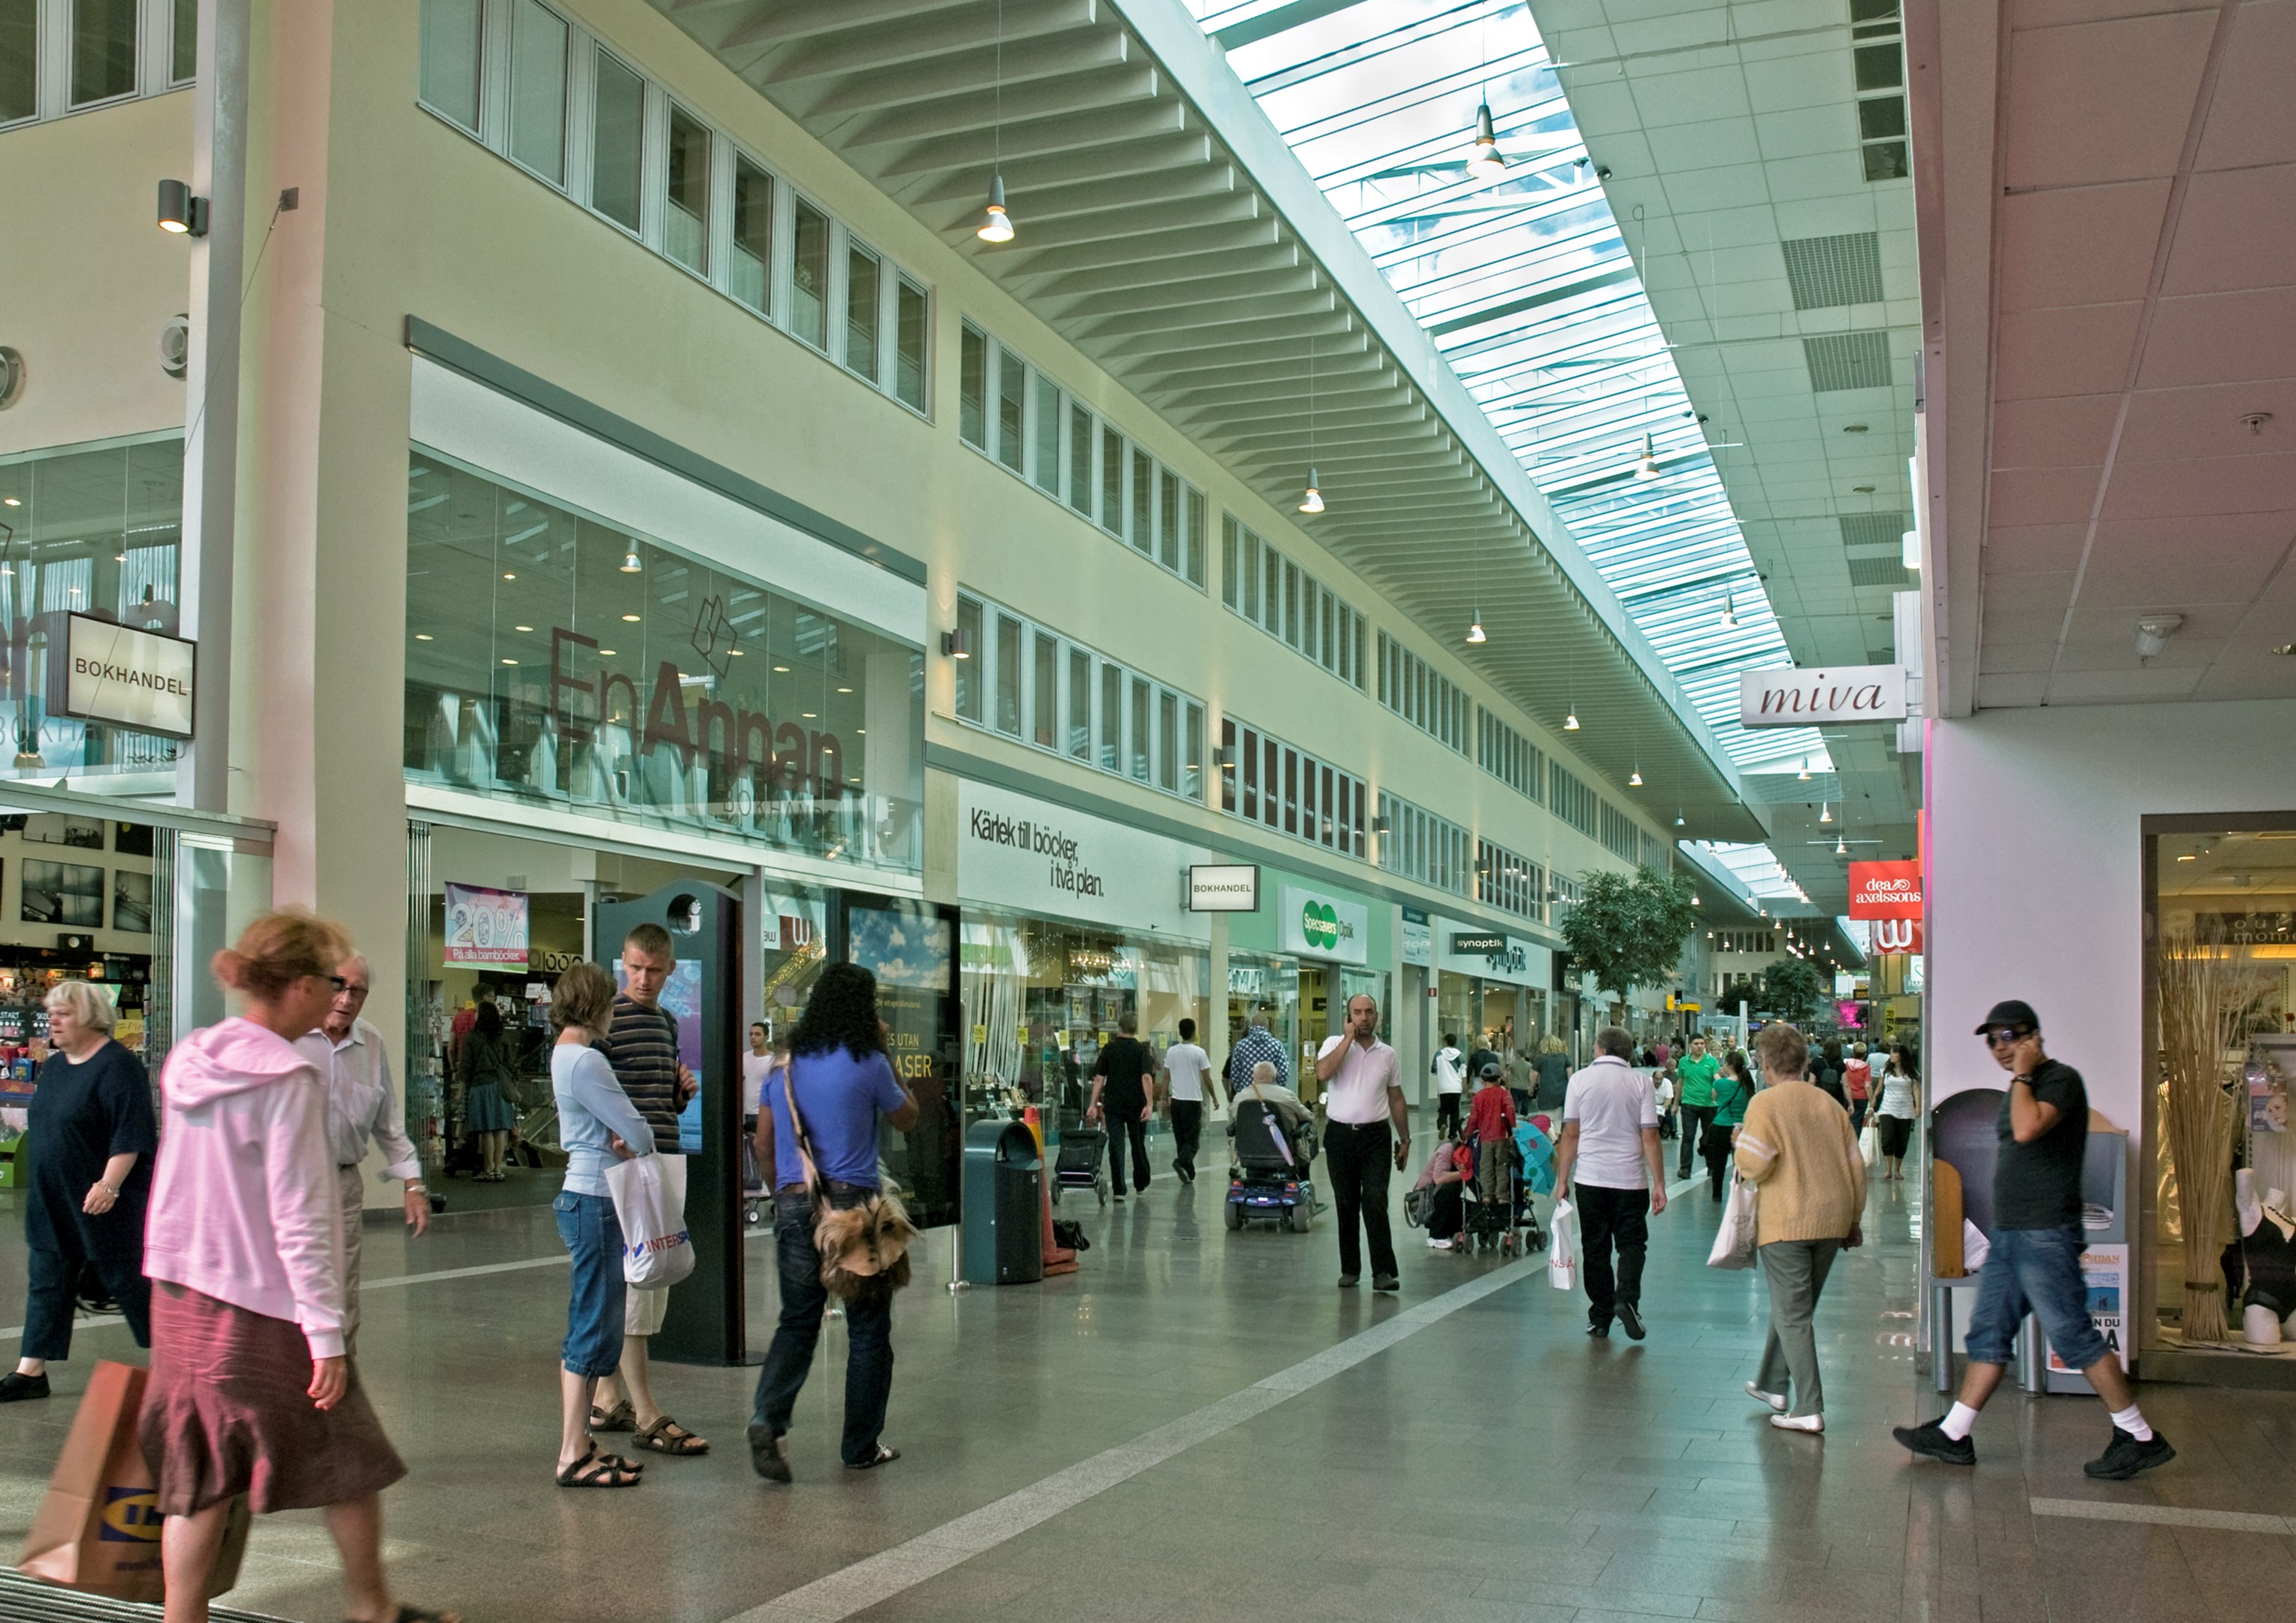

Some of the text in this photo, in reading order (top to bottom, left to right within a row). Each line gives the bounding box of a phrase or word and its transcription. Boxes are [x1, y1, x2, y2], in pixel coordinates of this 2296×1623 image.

[76, 657, 187, 696] BOKHANDEL
[1760, 673, 1886, 714] miva
[972, 807, 1078, 866] Kärlek till böcker,
[1051, 860, 1104, 899] i två plan.
[1866, 878, 1903, 891] dea
[1193, 884, 1251, 893] BOKHANDEL
[1856, 890, 1922, 903] axelssons
[450, 902, 526, 948] 20%
[1304, 913, 1336, 935] Specsavers
[1339, 920, 1354, 941] Optik
[1457, 938, 1503, 949] synoptik
[2234, 932, 2296, 941] mom
[453, 948, 463, 959] På
[1886, 1010, 1895, 1033] REA
[897, 1033, 919, 1047] UTAN
[2105, 1319, 2120, 1327] DU
